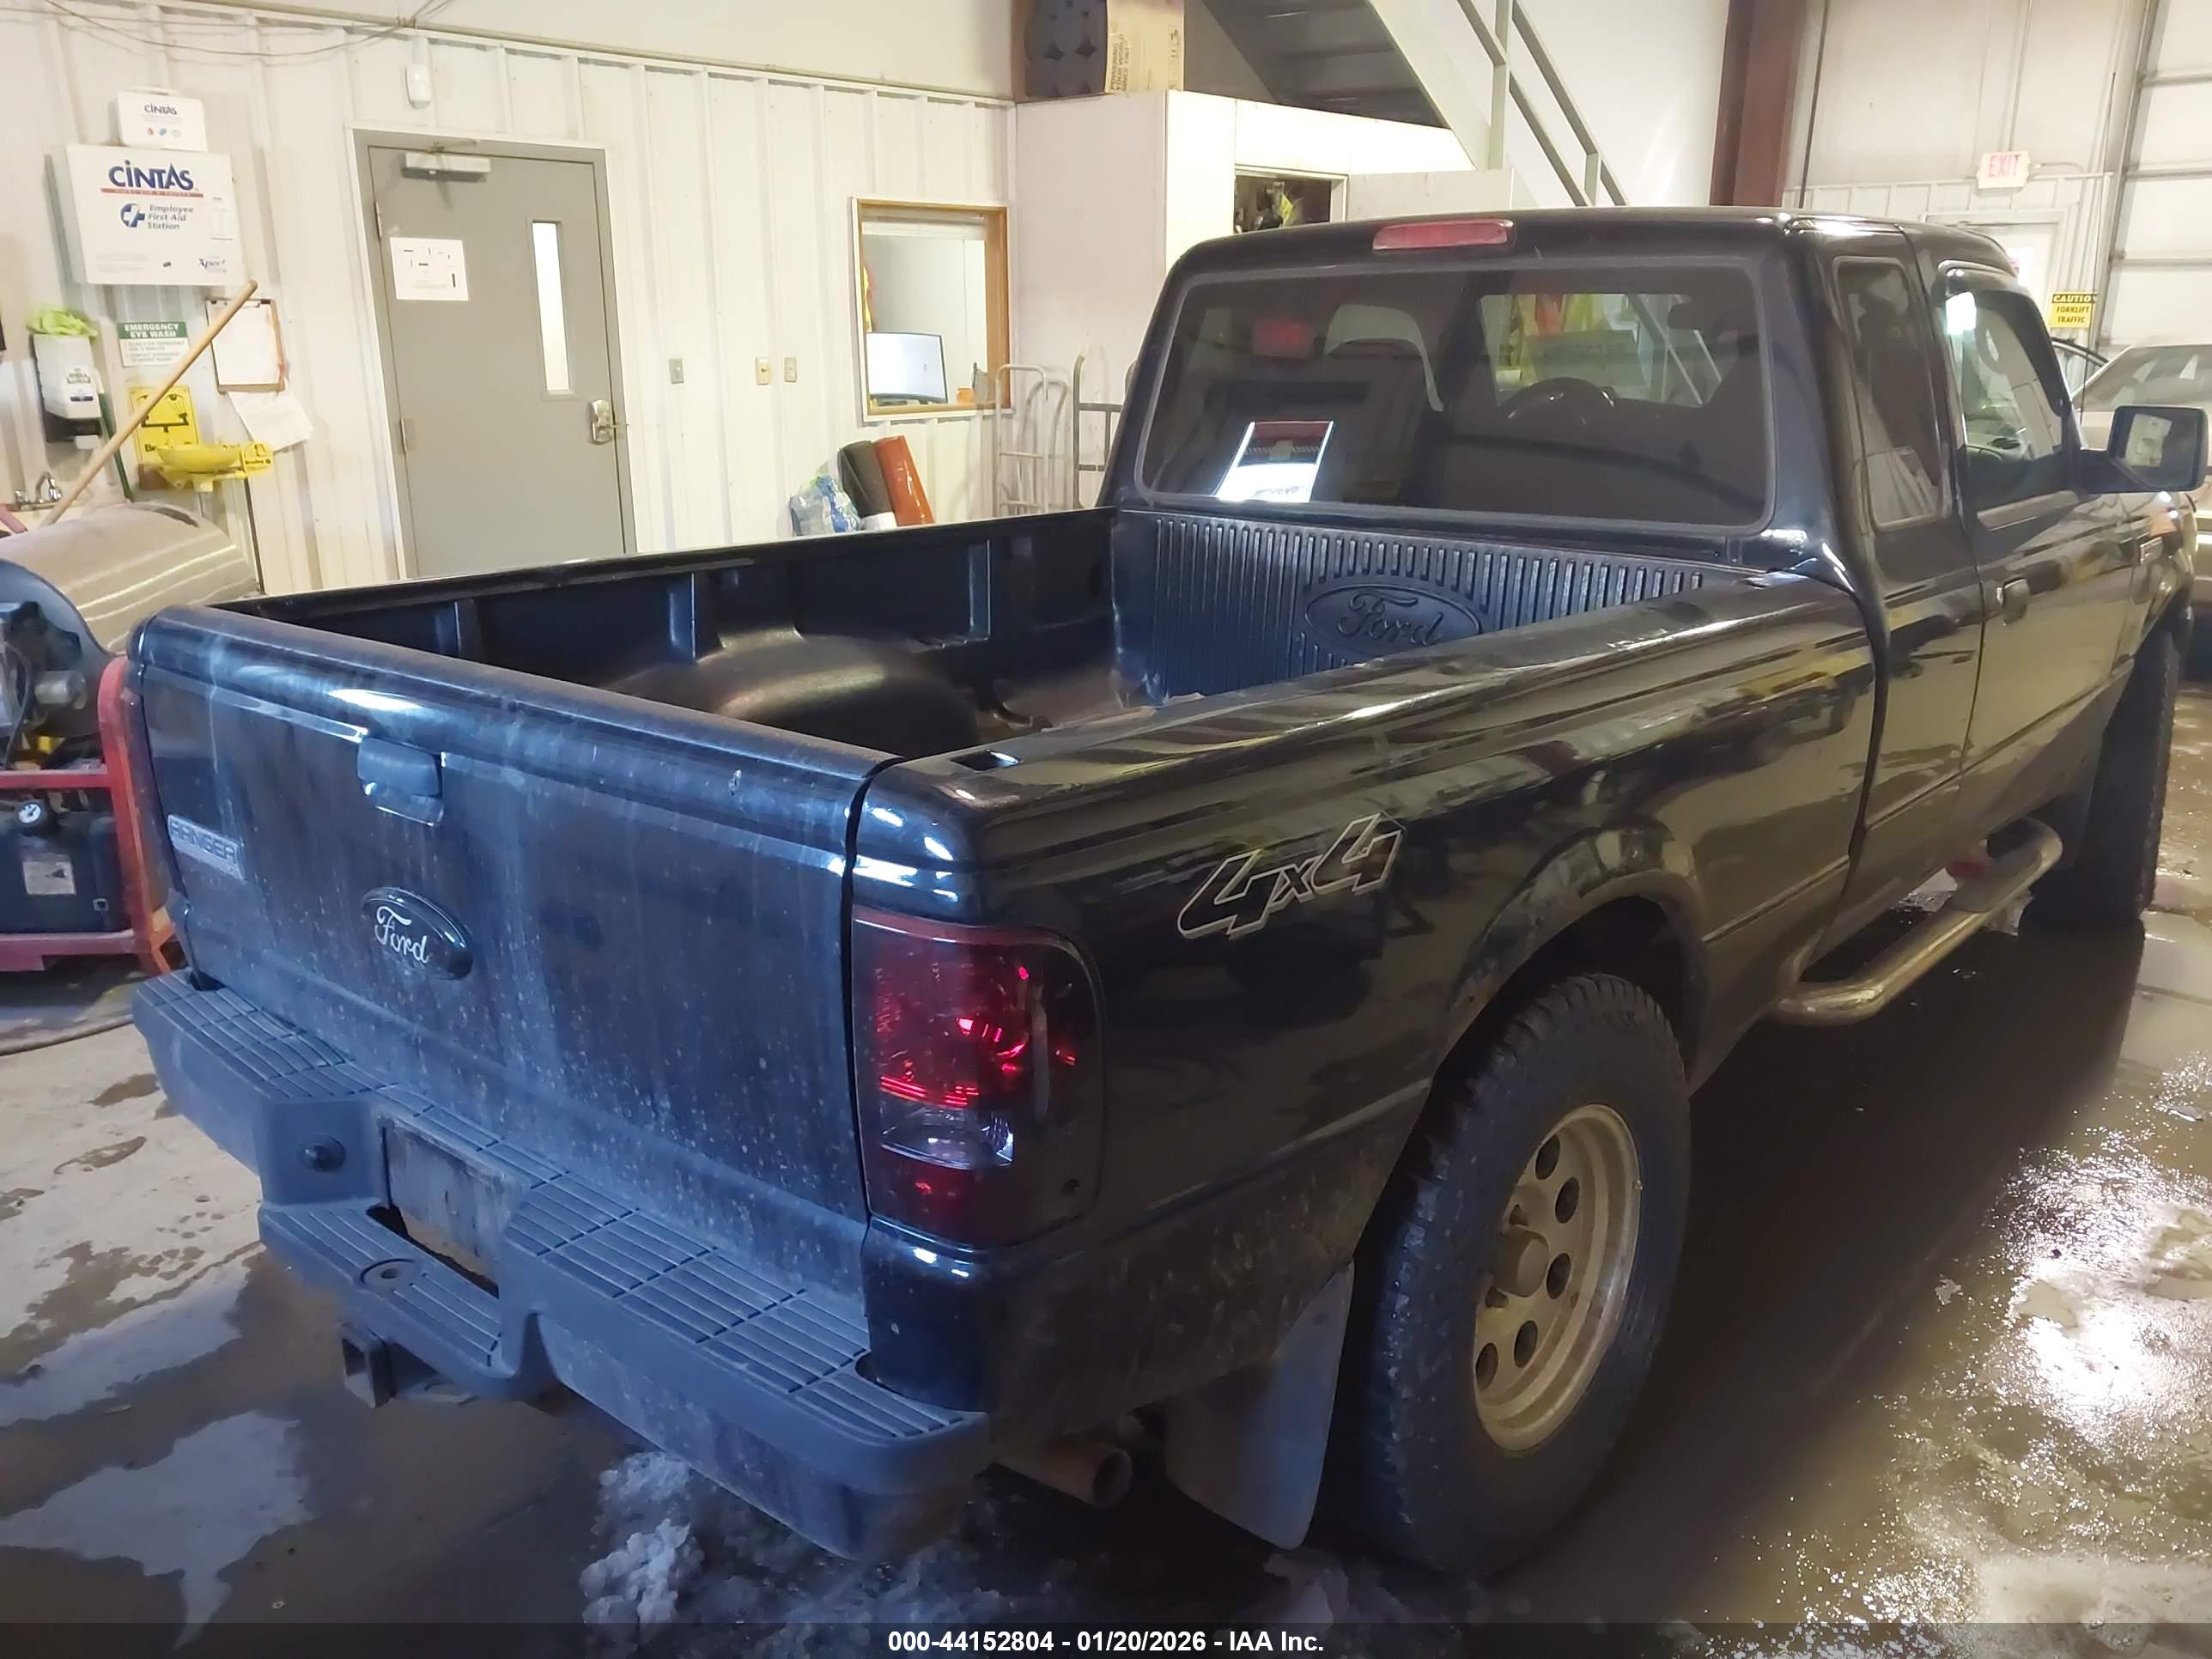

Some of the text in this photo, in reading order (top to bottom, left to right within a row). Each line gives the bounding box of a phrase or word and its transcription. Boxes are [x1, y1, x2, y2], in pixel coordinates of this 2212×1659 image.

[1989, 155, 2021, 178] EXIT
[149, 204, 194, 214] Employee
[148, 222, 180, 230] Station
[2052, 295, 2097, 303] CAUTIO
[124, 323, 179, 331] EMERGENCY
[1338, 590, 1445, 647] Ford
[1177, 811, 1402, 940] 4x4
[374, 905, 429, 963] Ford
